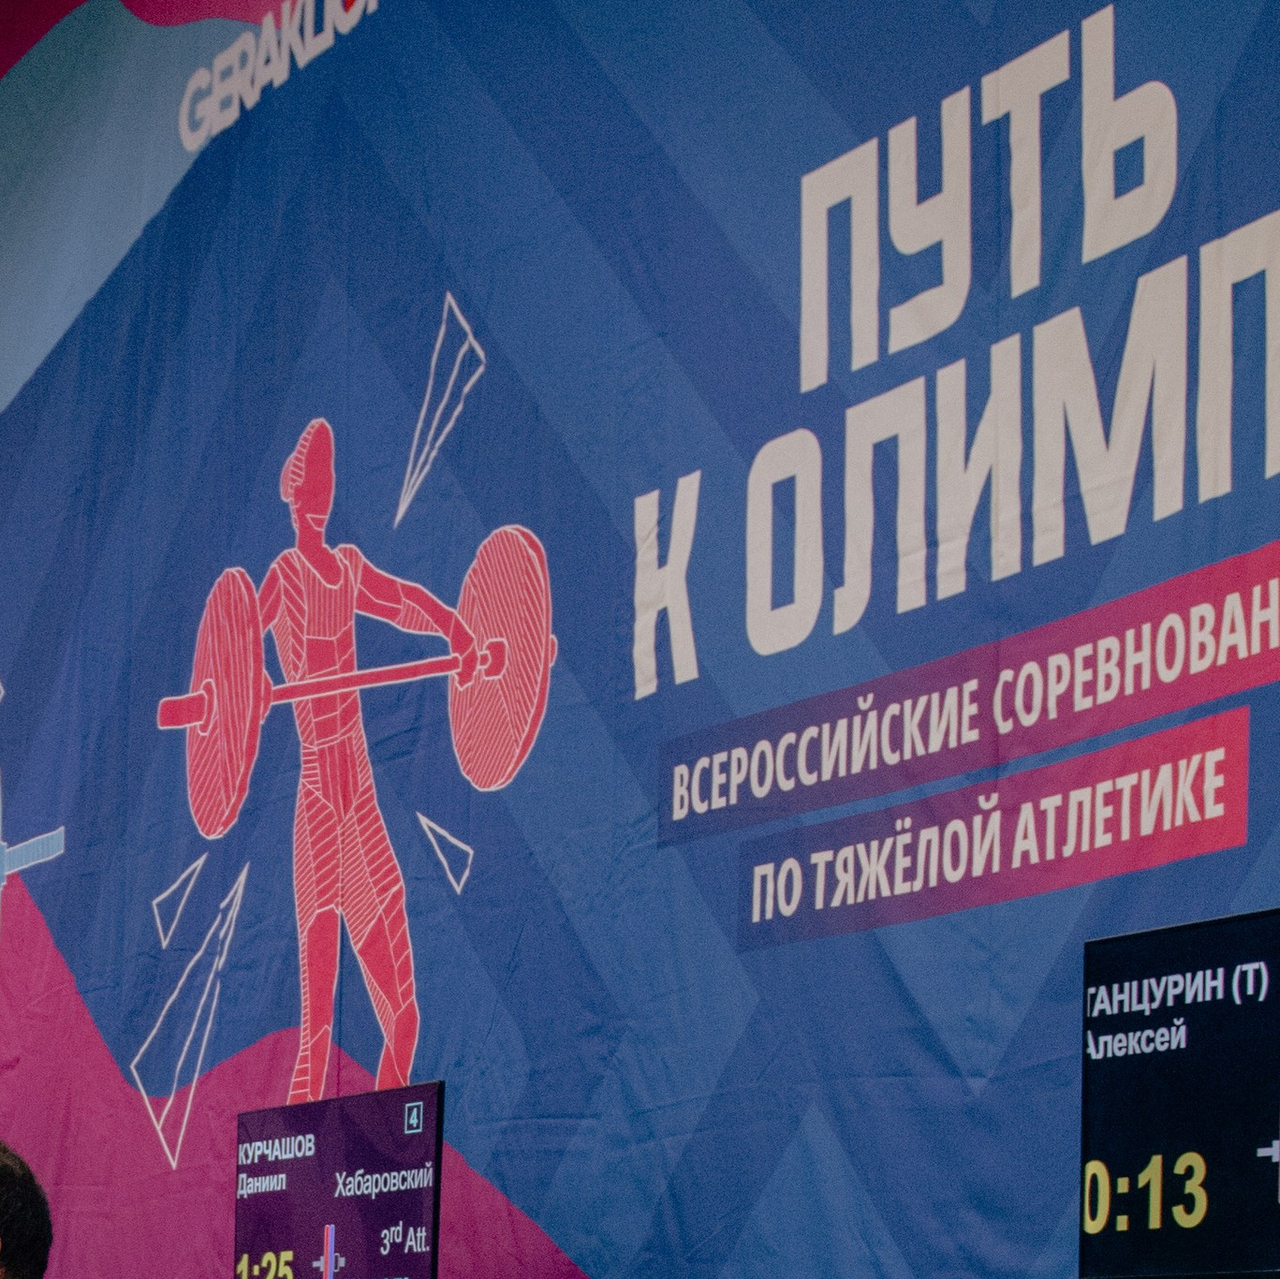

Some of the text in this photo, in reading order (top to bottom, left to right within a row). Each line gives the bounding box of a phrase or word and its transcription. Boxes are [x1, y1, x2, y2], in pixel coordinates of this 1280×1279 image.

[800, 3, 1178, 394] ПУТЬ
[633, 208, 1280, 701] К ОЛИМП
[672, 576, 1280, 822] ВСЕРОССИЙСКИЕ СОРЕВНОВАН
[752, 747, 1226, 923] ПО ТЯЖЁЛОЙ АТЛЕТИКЕ
[408, 1108, 419, 1128] 4
[237, 1133, 316, 1165] КУРЧАШОВ
[236, 1172, 287, 1199] Даниил
[334, 1161, 434, 1200] Хабаровский
[1083, 1151, 1209, 1235] 0:13
[380, 1221, 431, 1256] 3rd Att.
